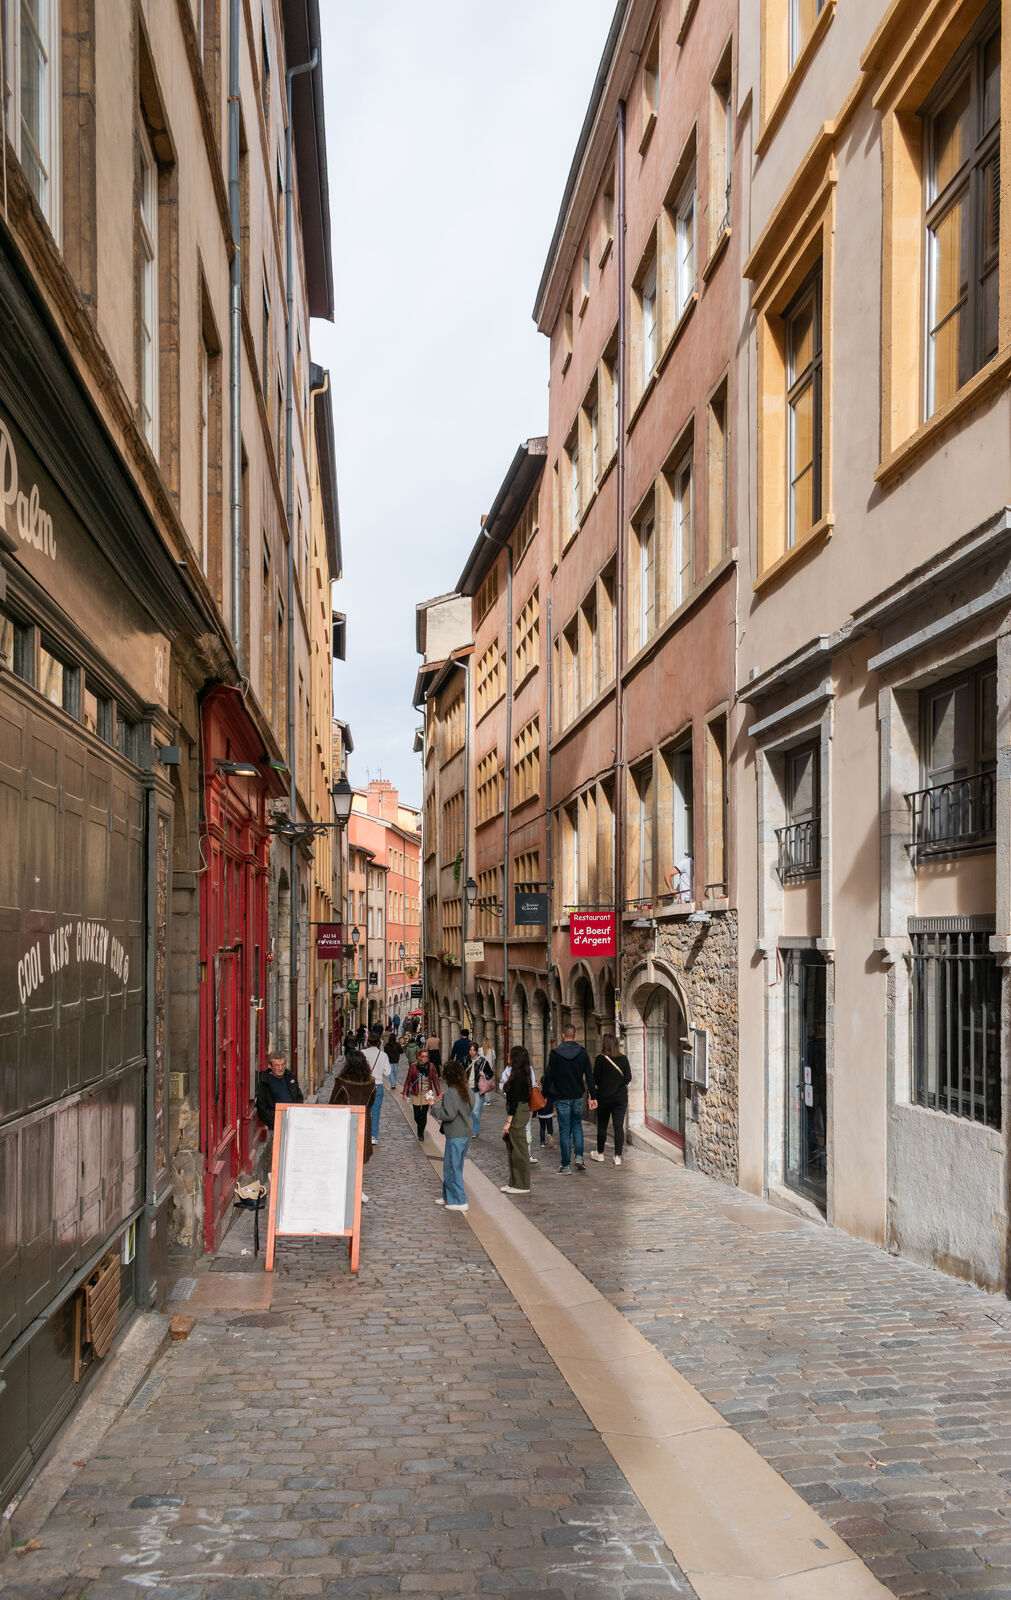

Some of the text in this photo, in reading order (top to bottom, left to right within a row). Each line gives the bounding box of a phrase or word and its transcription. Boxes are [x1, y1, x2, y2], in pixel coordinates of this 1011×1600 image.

[154, 645, 163, 693] 38
[573, 926, 611, 935] Le Boeuf
[574, 936, 611, 946] d'Argent
[18, 941, 44, 1004] COOL
[76, 921, 109, 965] COOKERY
